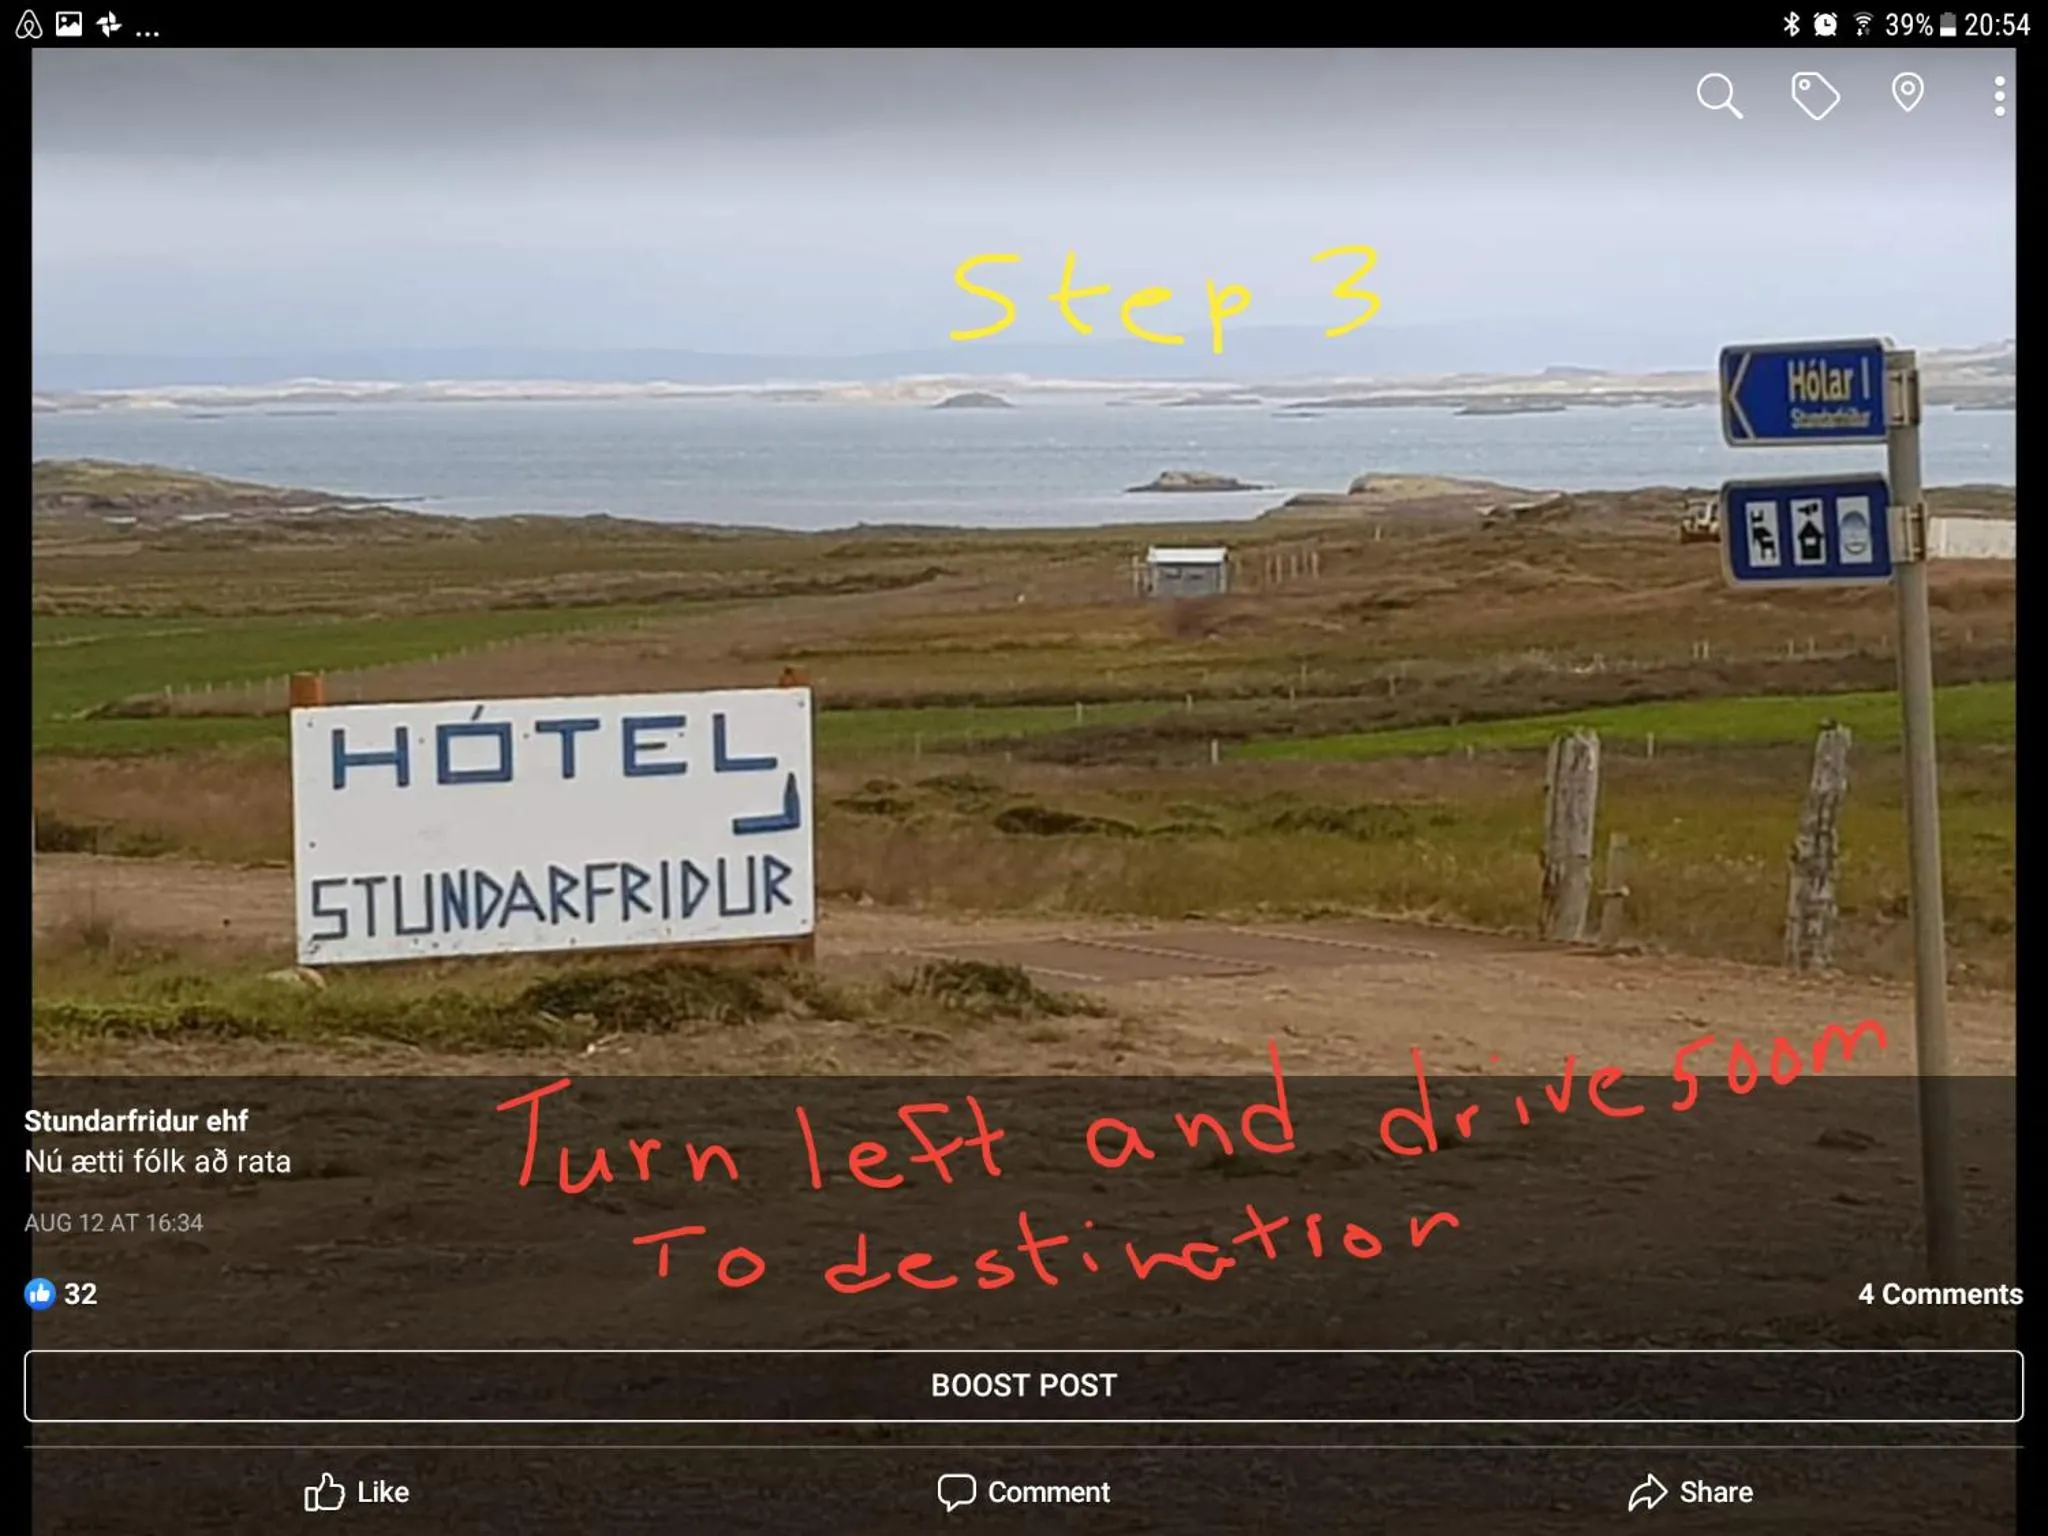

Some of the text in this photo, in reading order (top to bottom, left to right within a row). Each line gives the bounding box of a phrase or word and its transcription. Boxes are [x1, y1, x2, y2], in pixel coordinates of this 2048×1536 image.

[1787, 358, 1854, 402] Hólar
[331, 704, 779, 790] HÓTEL
[311, 854, 793, 942] STUNDARFRIDUR
